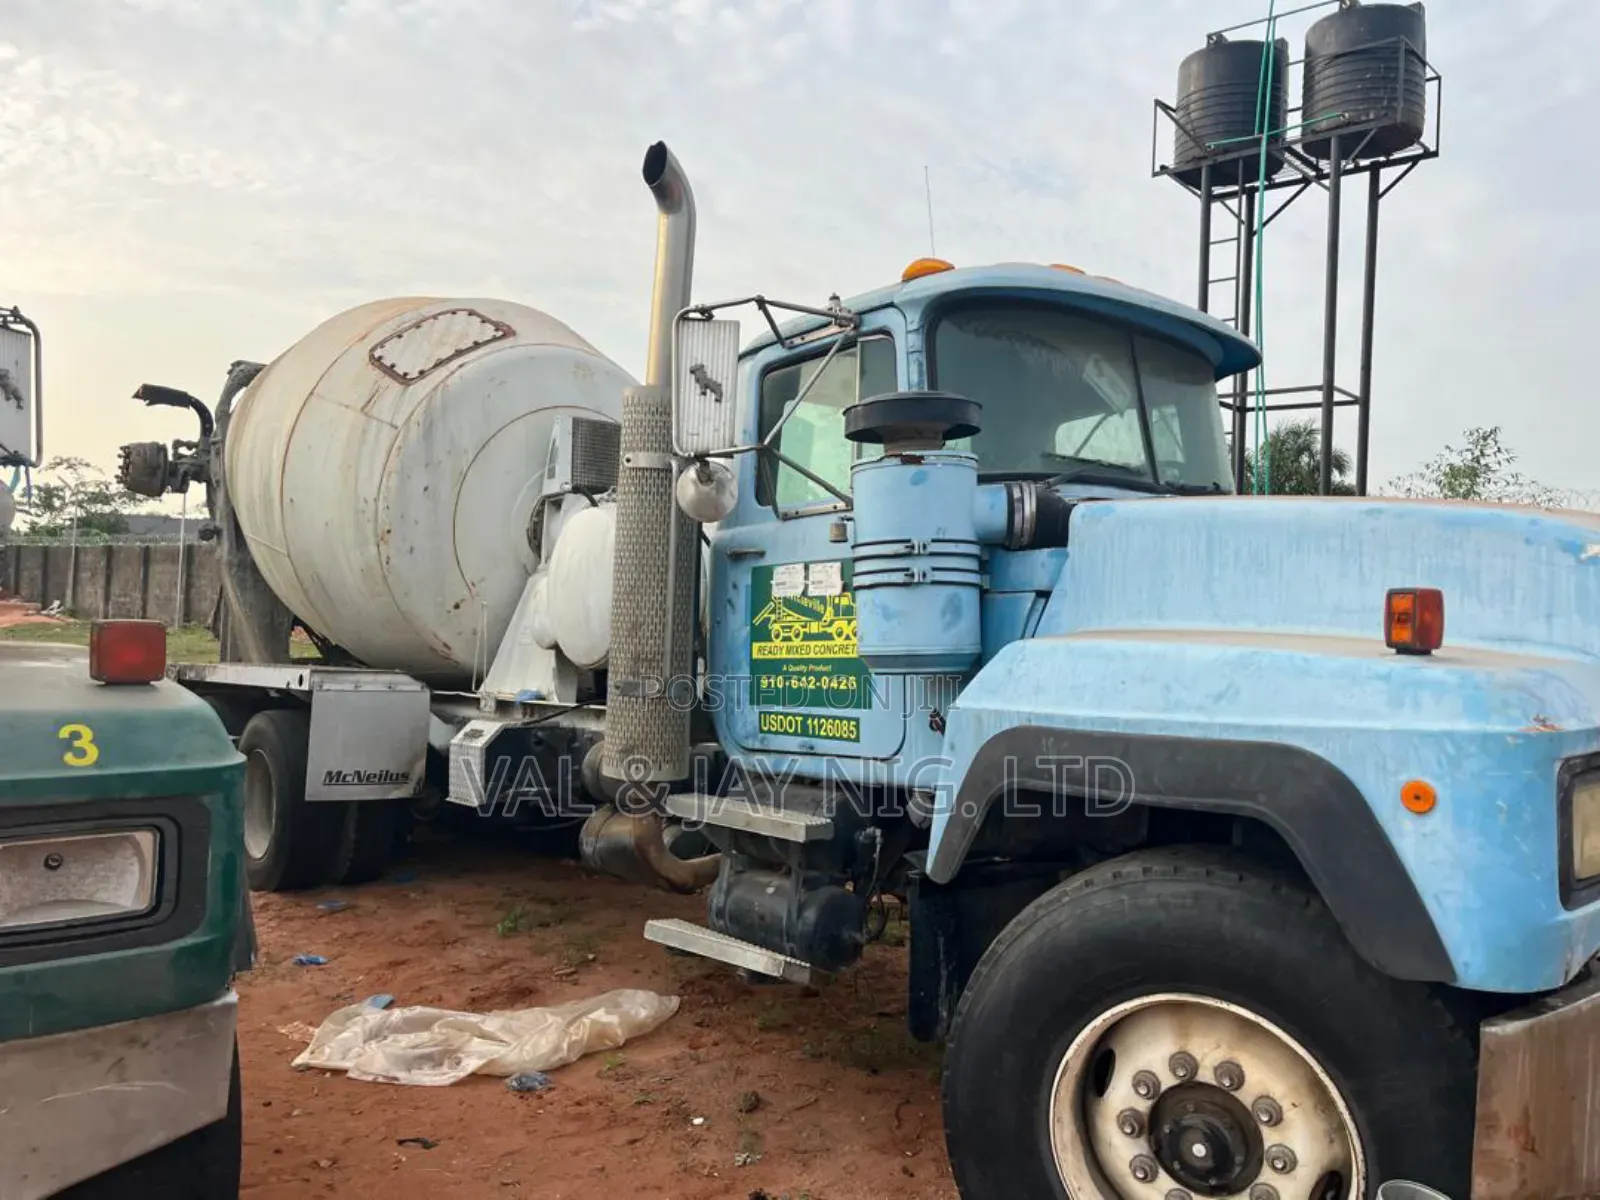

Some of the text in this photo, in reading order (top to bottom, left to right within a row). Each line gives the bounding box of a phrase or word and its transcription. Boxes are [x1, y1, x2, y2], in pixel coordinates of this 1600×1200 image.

[757, 643, 857, 656] READY MIXED CONCRET
[782, 664, 832, 673] A Quality Product
[760, 713, 857, 739] USDOT 1126085
[58, 723, 100, 767] 3
[323, 769, 411, 785] McNeilus
